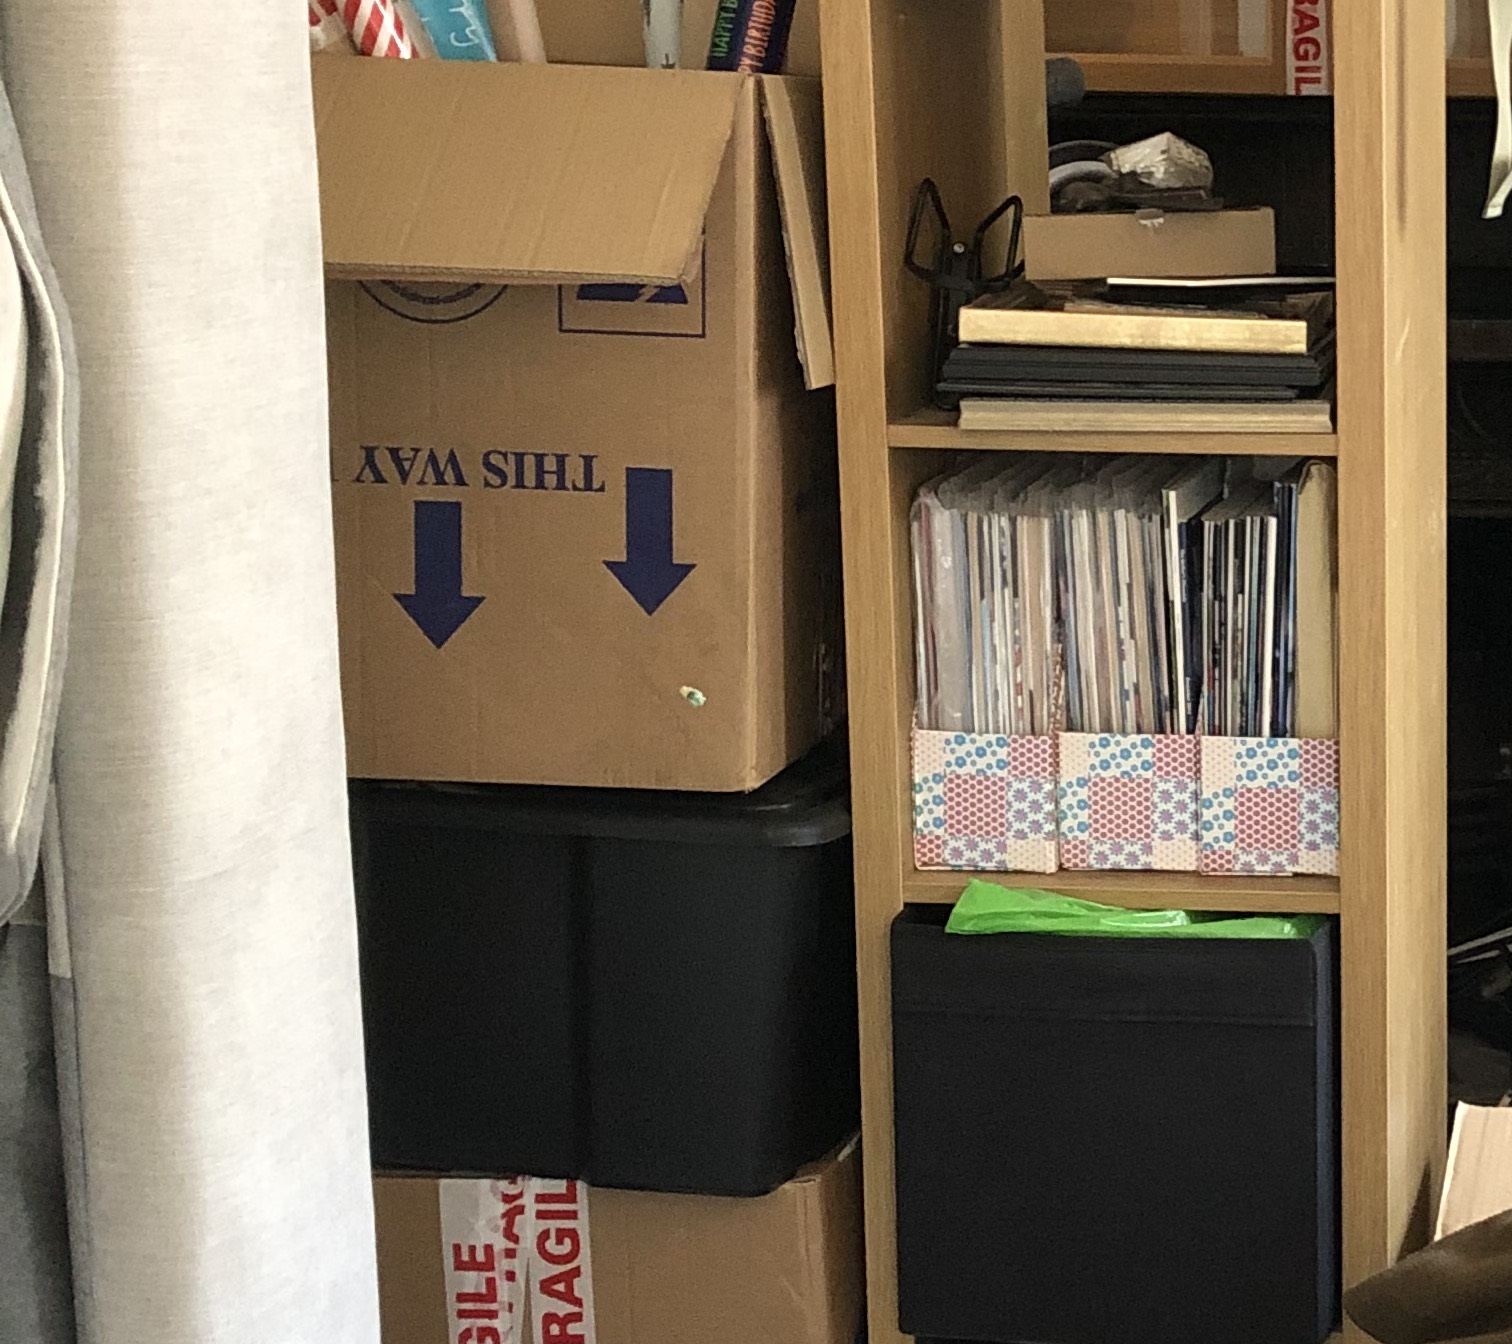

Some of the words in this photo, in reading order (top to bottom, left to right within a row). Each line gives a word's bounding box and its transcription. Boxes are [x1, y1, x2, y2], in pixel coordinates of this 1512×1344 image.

[712, 9, 736, 58] HAPPY
[355, 445, 468, 487] WAY
[482, 451, 606, 492] THIS
